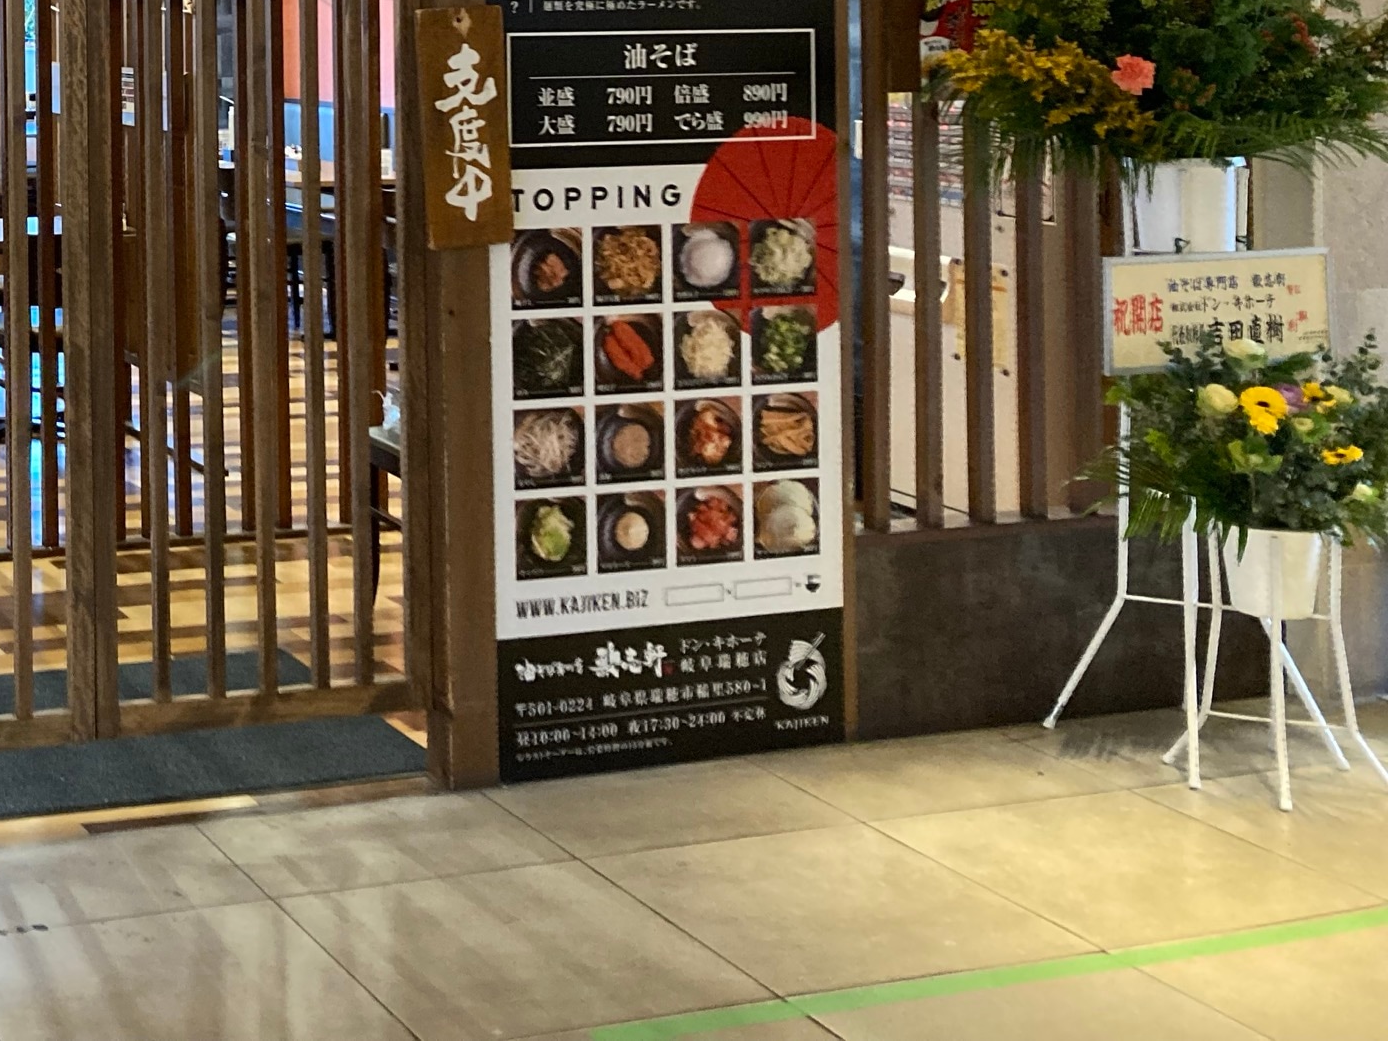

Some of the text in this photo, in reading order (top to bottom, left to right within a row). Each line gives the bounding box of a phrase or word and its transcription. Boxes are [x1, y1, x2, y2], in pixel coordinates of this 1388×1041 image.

[624, 43, 698, 69] 油そば
[538, 87, 575, 107] 並盛
[606, 85, 653, 105] 790円
[743, 83, 788, 102] 890円
[538, 110, 788, 135] 大盛 790円 でら盛 990円
[513, 184, 682, 213] TOPPING
[1113, 293, 1163, 336] 祝開店
[516, 589, 649, 619] WWW.KAJIKEN.BIZ
[776, 715, 829, 731] KAJIKEN
